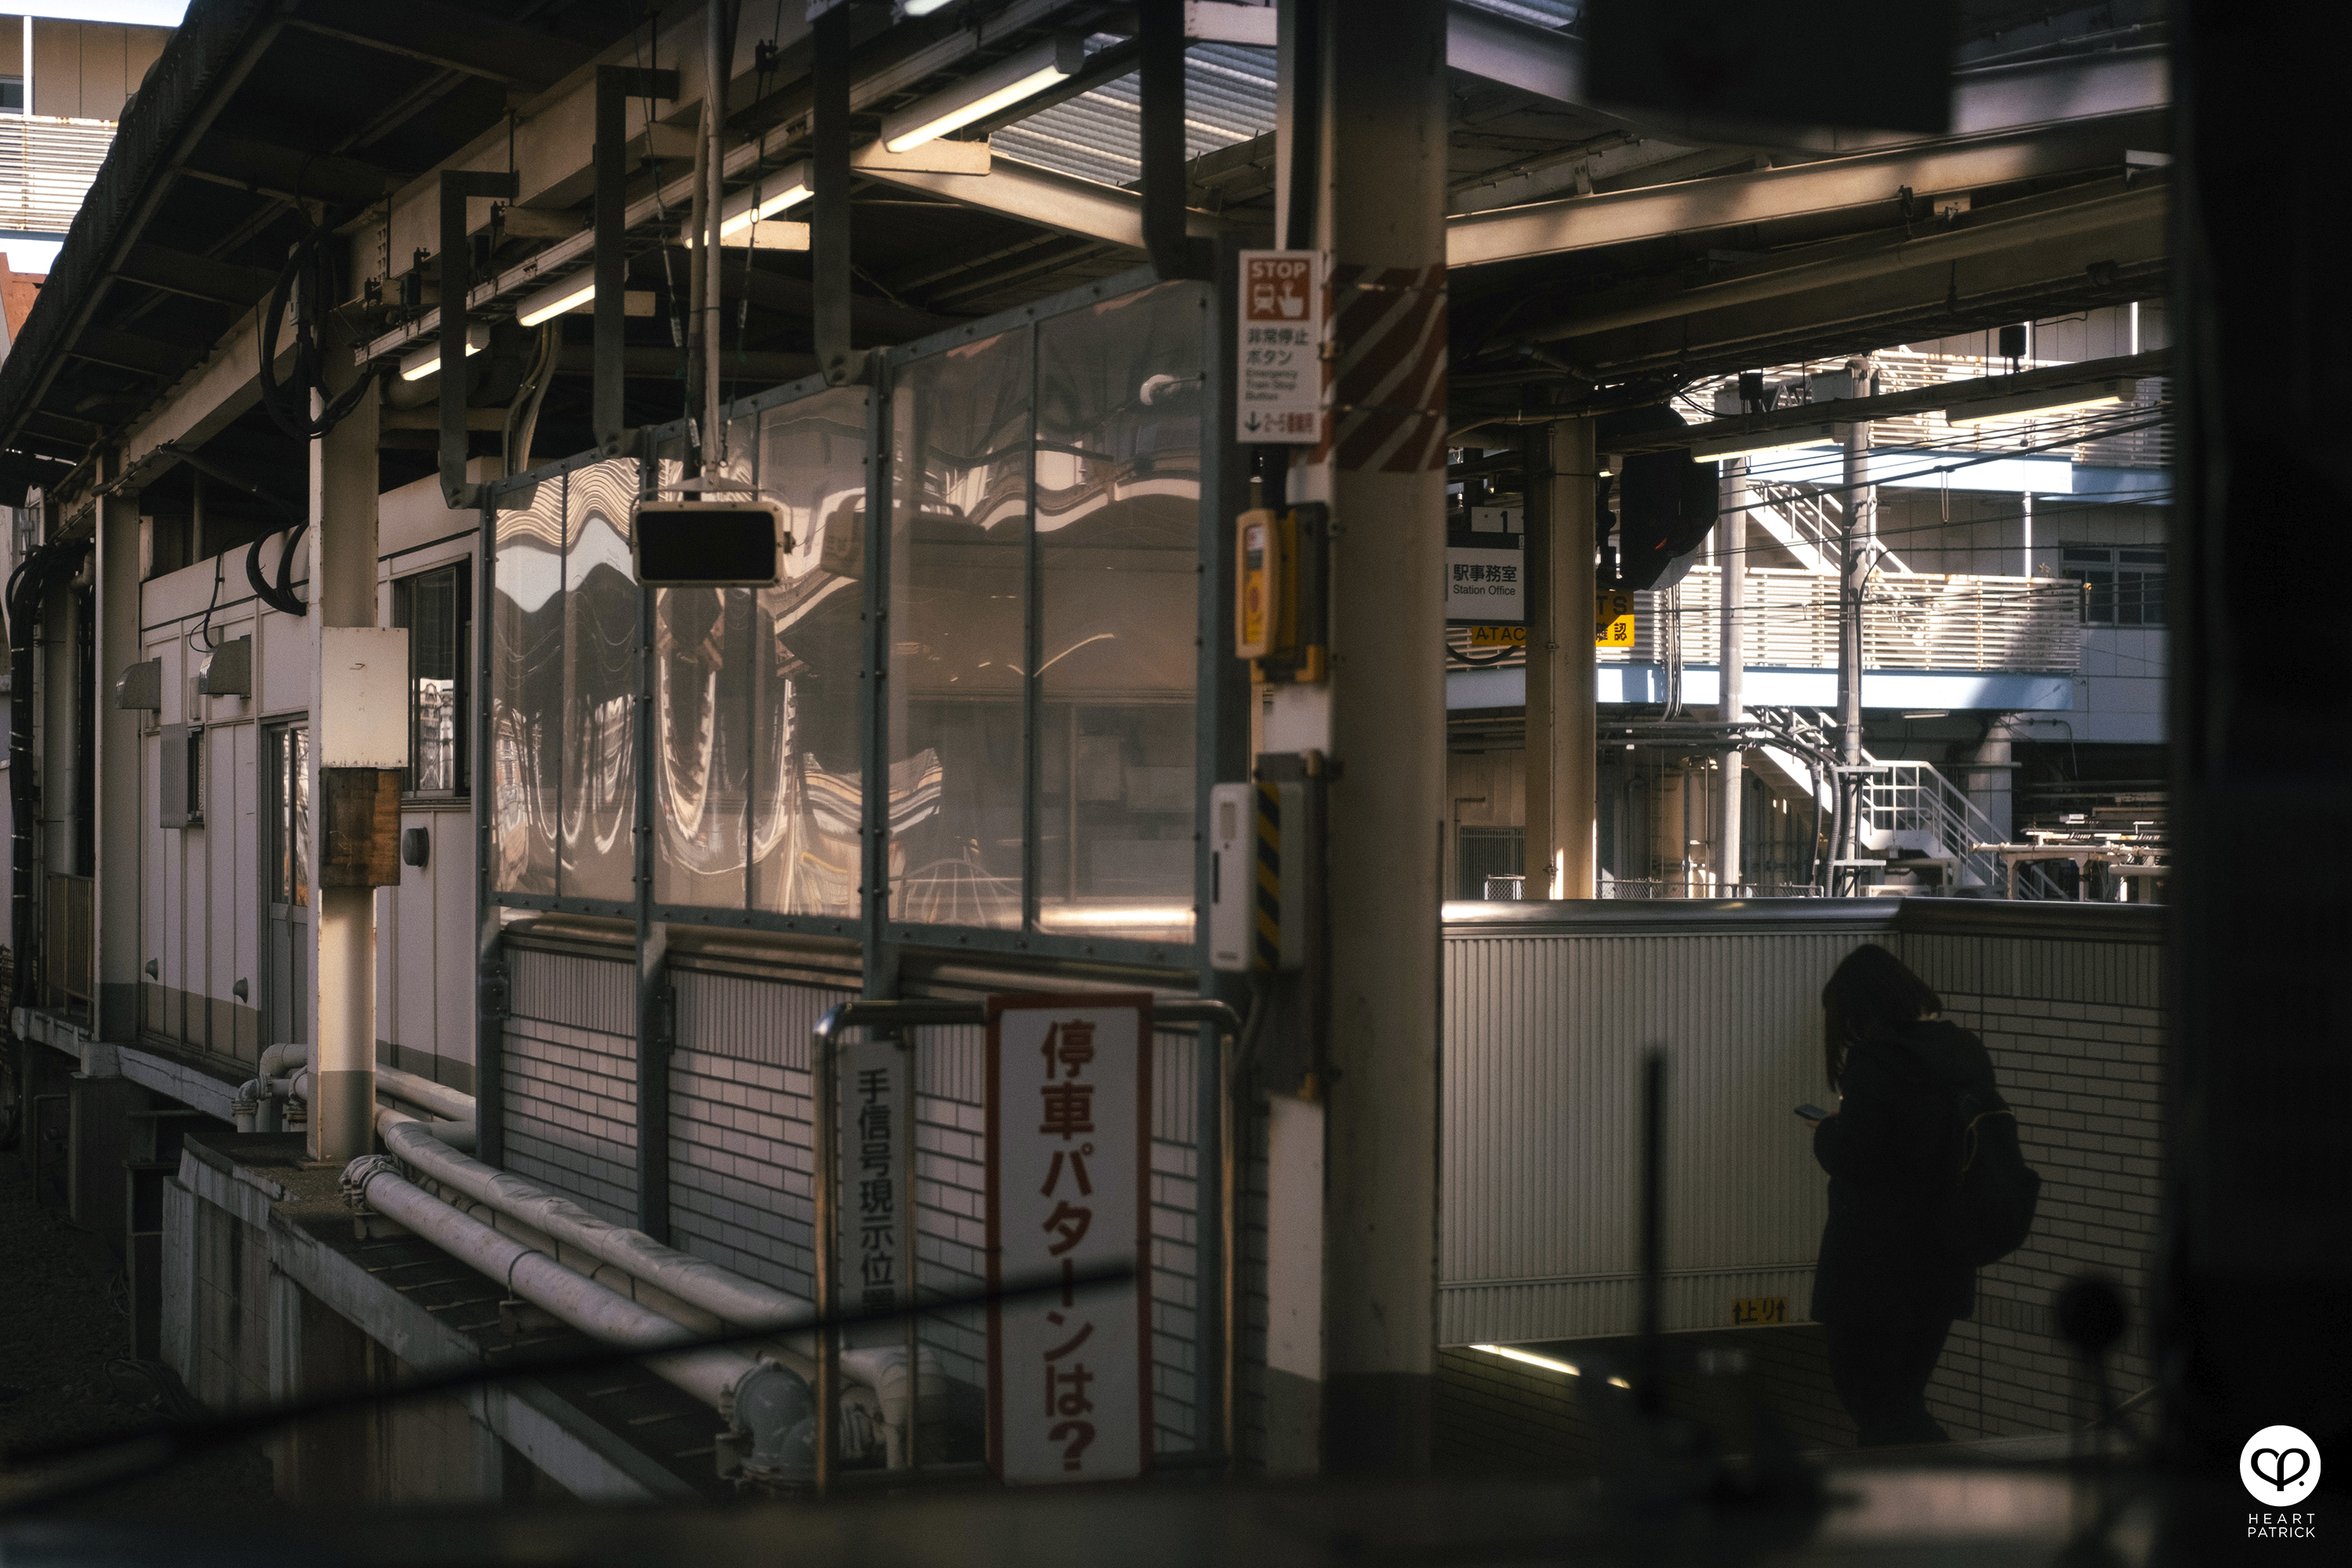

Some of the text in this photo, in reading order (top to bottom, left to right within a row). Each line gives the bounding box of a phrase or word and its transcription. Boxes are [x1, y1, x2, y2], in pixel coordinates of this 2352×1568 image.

[1251, 261, 1307, 278] STOP
[1248, 328, 1308, 346] 非常停止
[1246, 349, 1293, 365] ボタン
[1501, 510, 1508, 533] 1
[1454, 564, 1517, 583] 駅事務室
[1454, 584, 1516, 596] Station Office
[1040, 1020, 1095, 1472] 停車パターンは?
[1740, 1299, 1774, 1323] 上り
